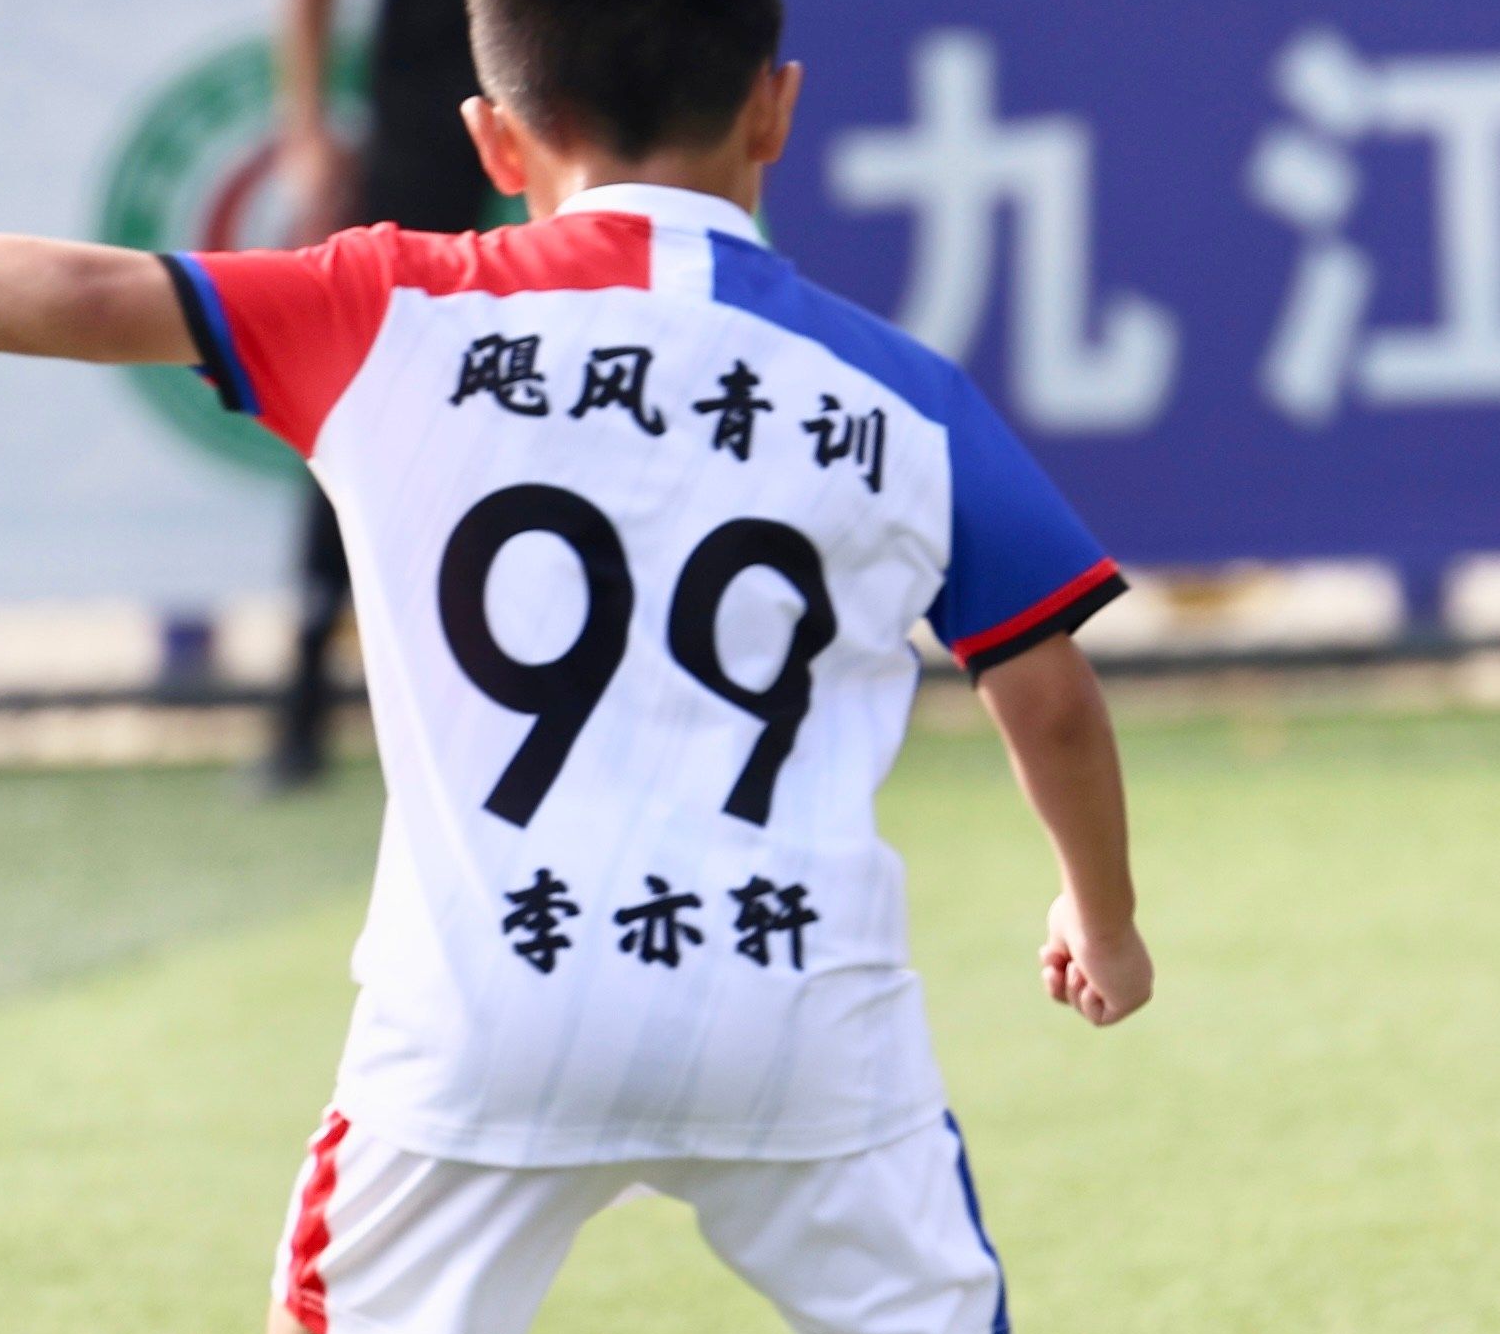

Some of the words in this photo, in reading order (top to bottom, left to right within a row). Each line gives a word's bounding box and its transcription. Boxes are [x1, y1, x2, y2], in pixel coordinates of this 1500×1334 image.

[448, 332, 886, 494] 飓风青训
[438, 482, 838, 829] 99
[503, 867, 820, 973] 李亦轩
